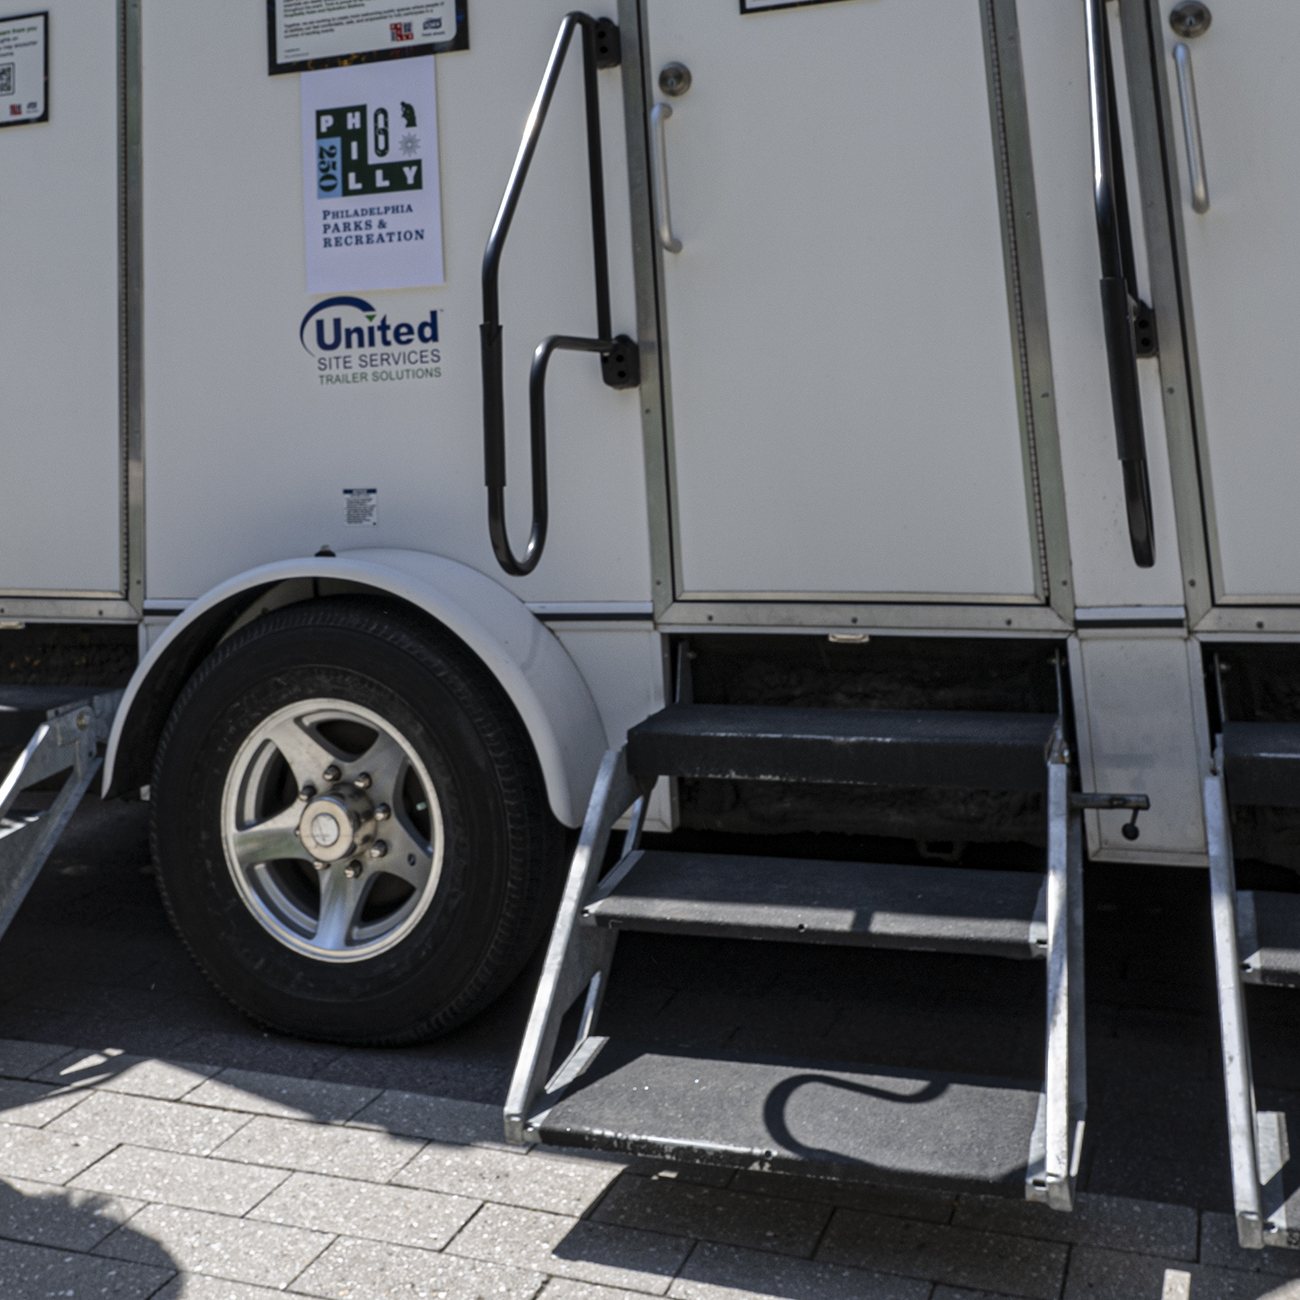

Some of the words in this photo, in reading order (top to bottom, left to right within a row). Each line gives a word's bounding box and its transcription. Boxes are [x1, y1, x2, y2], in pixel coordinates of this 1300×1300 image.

[319, 145, 338, 192] 250
[322, 204, 414, 220] PHILADELPHIA
[323, 220, 373, 234] PARKS
[377, 219, 387, 229] &
[323, 229, 425, 248] RECREATION
[316, 310, 439, 351] United
[317, 355, 352, 371] SITE
[358, 348, 441, 368] SERVICES
[318, 371, 369, 385] TRAILER
[371, 366, 442, 382] SOLUTIONS
